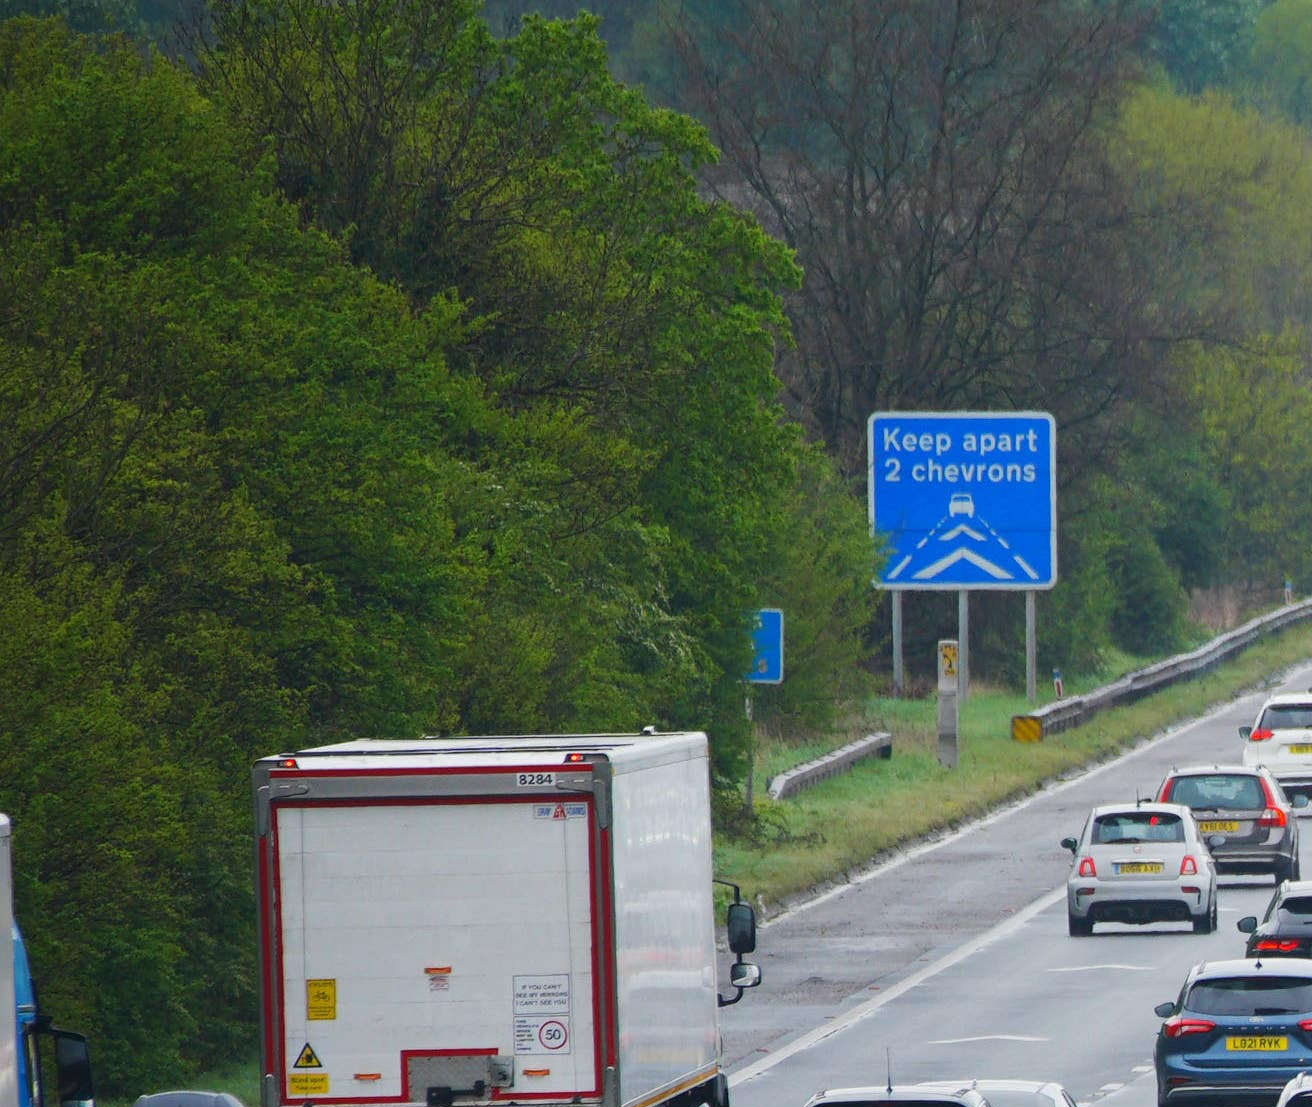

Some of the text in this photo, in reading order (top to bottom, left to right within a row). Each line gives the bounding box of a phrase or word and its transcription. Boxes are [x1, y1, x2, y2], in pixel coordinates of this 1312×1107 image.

[883, 427, 1039, 456] Keep apart
[885, 458, 1036, 483] 2 chevrons
[519, 774, 553, 785] 8284
[545, 1029, 561, 1041] 50
